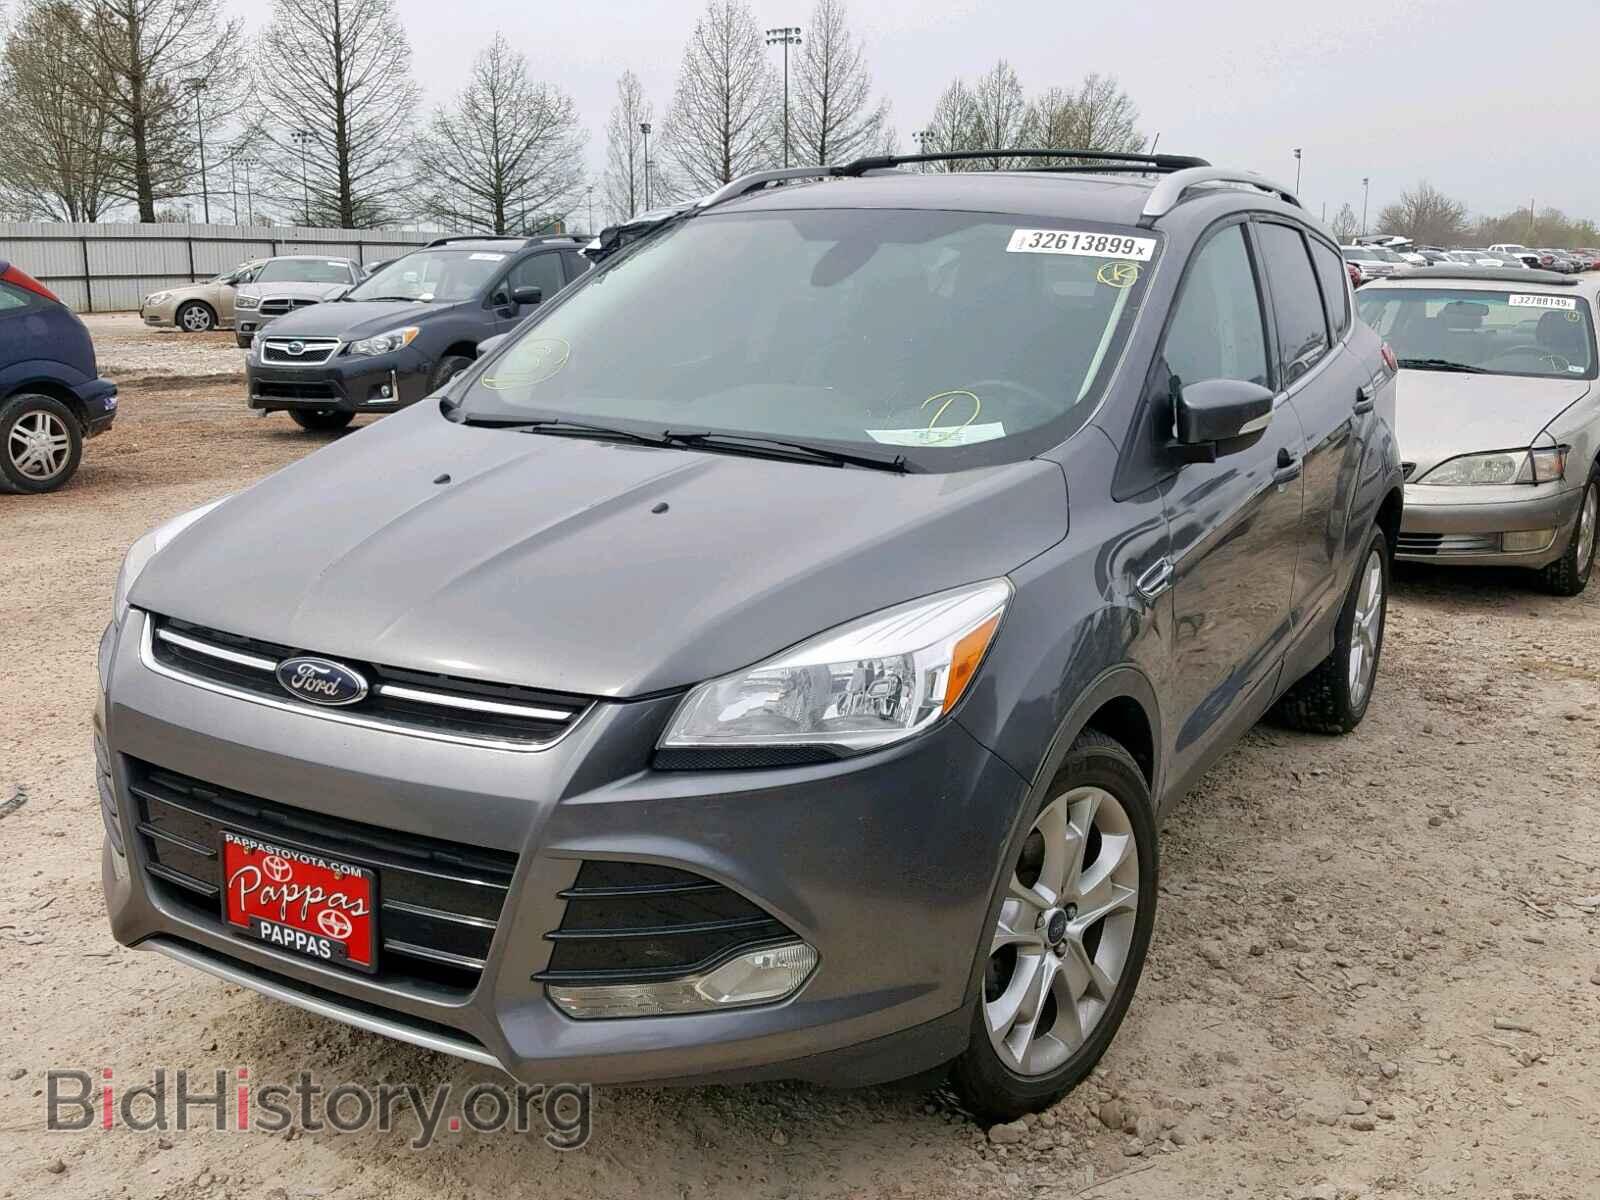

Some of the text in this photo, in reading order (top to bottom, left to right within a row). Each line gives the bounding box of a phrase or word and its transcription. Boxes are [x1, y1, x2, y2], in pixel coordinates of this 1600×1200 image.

[291, 663, 342, 696] Ford
[224, 833, 363, 879] PAPPASTOYOTA.COM
[228, 865, 370, 922] Pappas
[259, 921, 332, 959] PAPPAS
